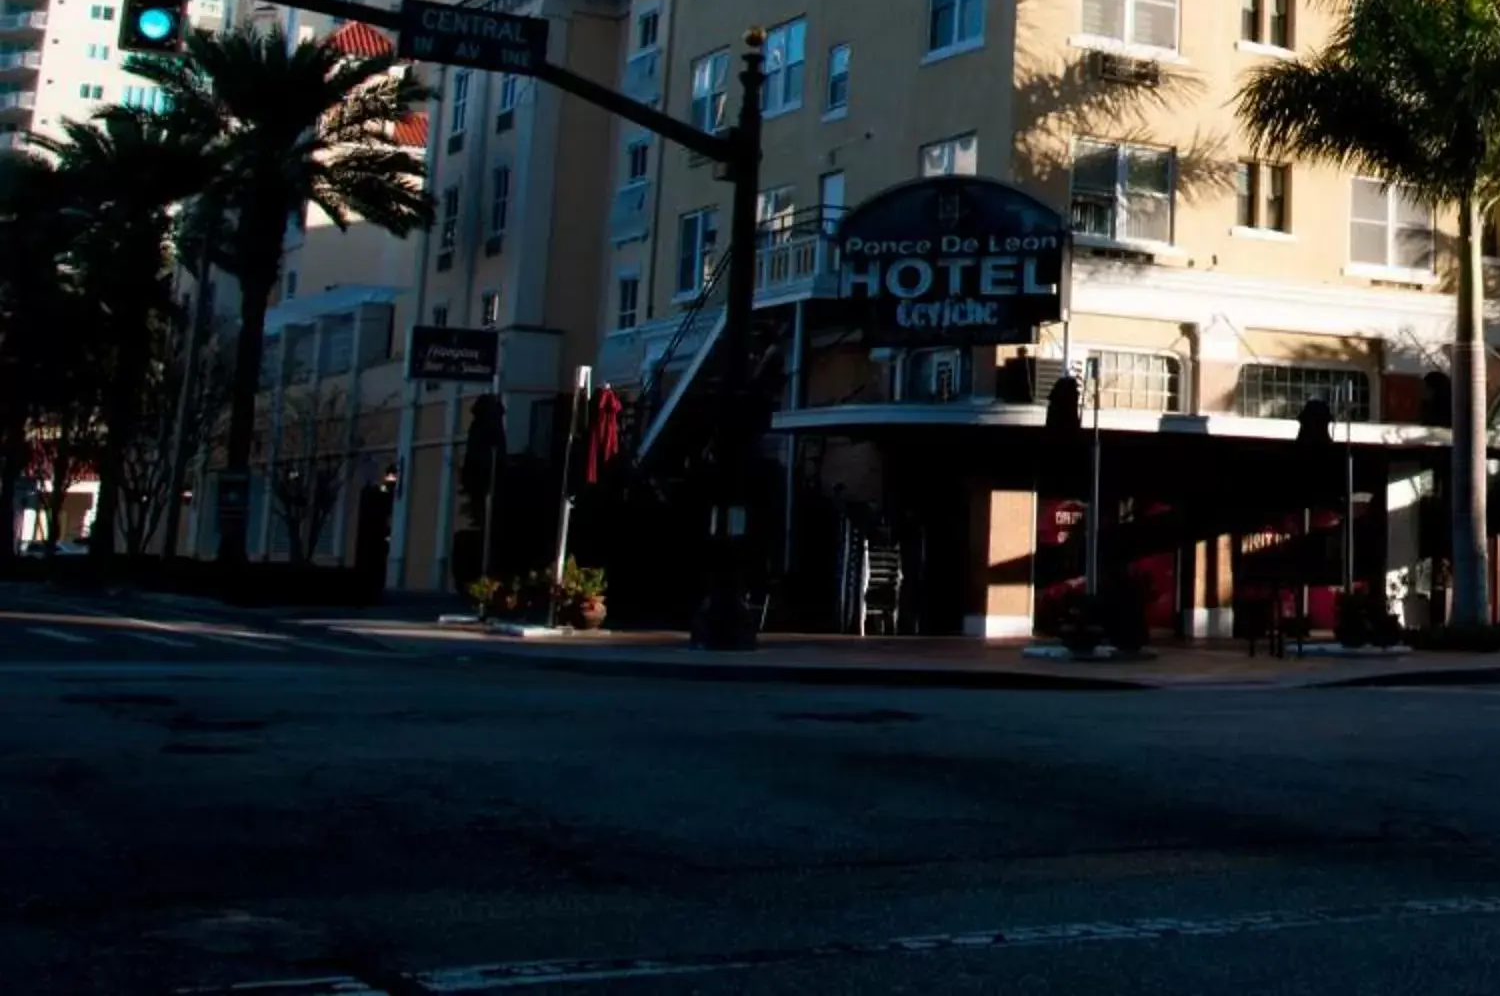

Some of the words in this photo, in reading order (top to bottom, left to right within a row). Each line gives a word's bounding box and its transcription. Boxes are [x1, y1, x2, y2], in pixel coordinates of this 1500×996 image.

[421, 7, 530, 45] CENTRAL
[845, 236, 932, 255] Ponce
[941, 235, 980, 253] De
[839, 256, 1056, 299] HOTEL
